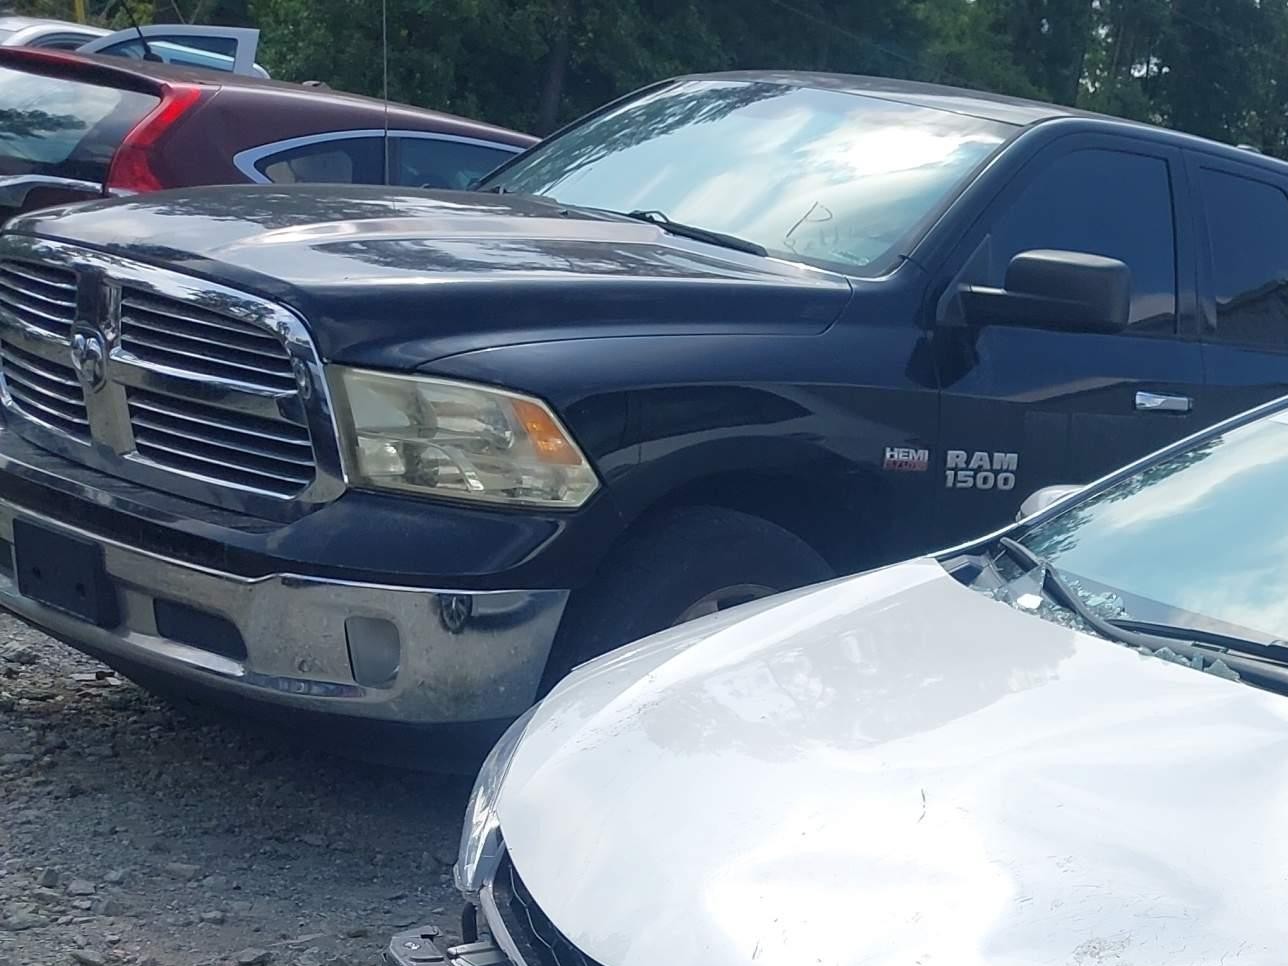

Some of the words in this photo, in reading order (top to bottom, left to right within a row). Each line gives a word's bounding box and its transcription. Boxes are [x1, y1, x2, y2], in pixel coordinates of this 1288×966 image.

[885, 446, 929, 462] HEMI
[945, 450, 1019, 470] RAM
[944, 470, 1016, 490] 1500
